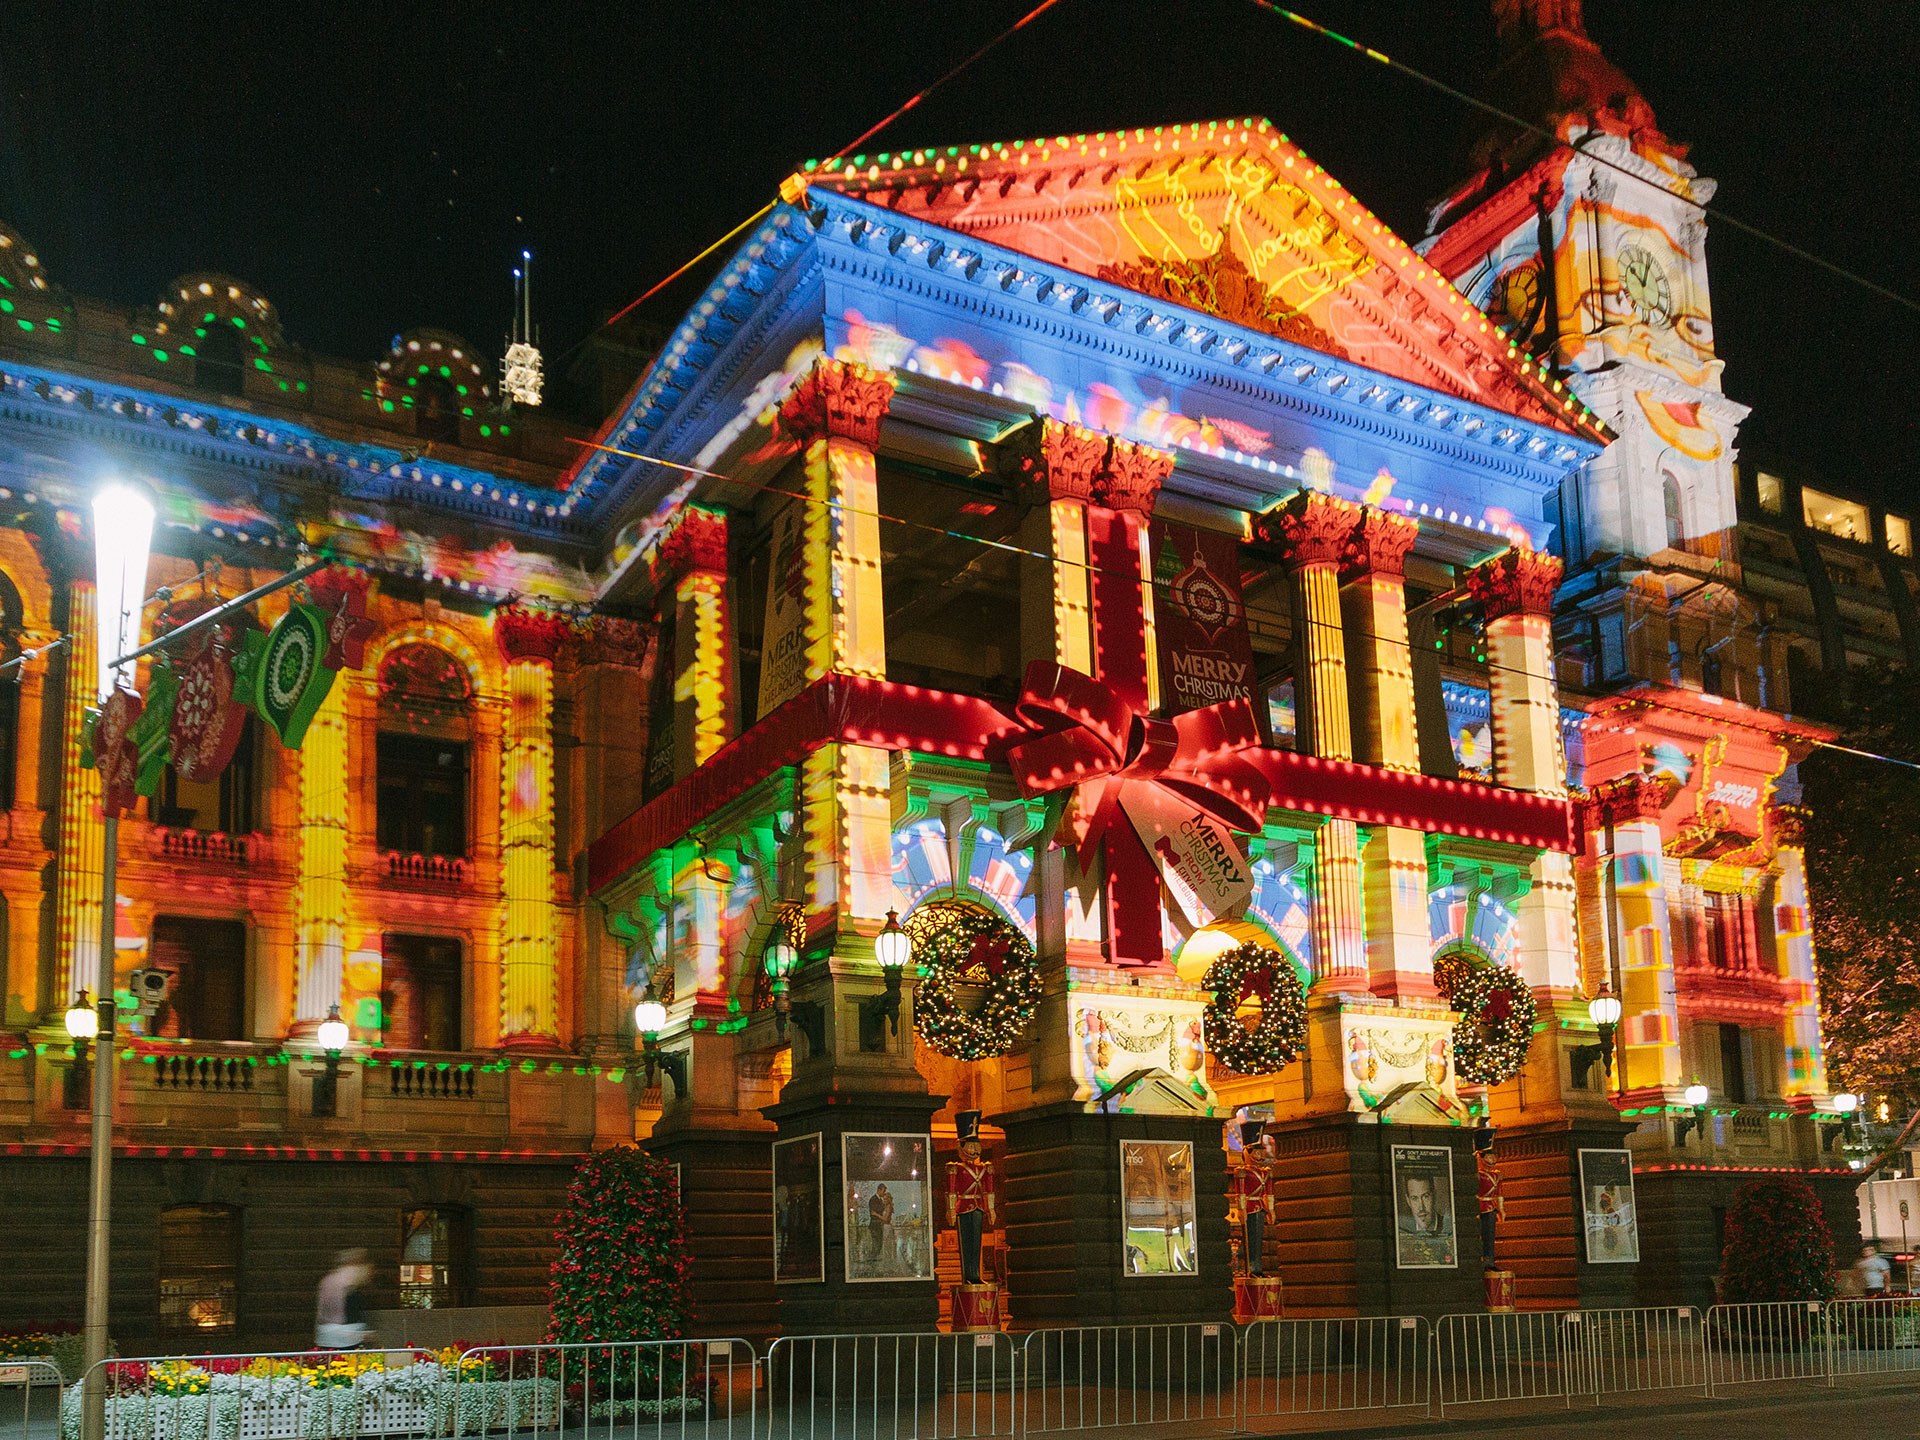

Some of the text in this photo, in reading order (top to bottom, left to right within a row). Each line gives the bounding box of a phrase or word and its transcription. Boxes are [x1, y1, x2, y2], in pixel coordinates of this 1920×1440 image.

[766, 623, 804, 673] MERR
[764, 650, 804, 692] CHRISTM
[1171, 650, 1247, 683] MERRY
[763, 670, 803, 706] MELBOUR
[1173, 674, 1252, 702] CHRISTMAS
[1180, 821, 1230, 898] CHRISTMAS
[1191, 813, 1245, 883] MERRY
[1177, 866, 1198, 893] CITY OF
[1182, 850, 1207, 886] FROM
